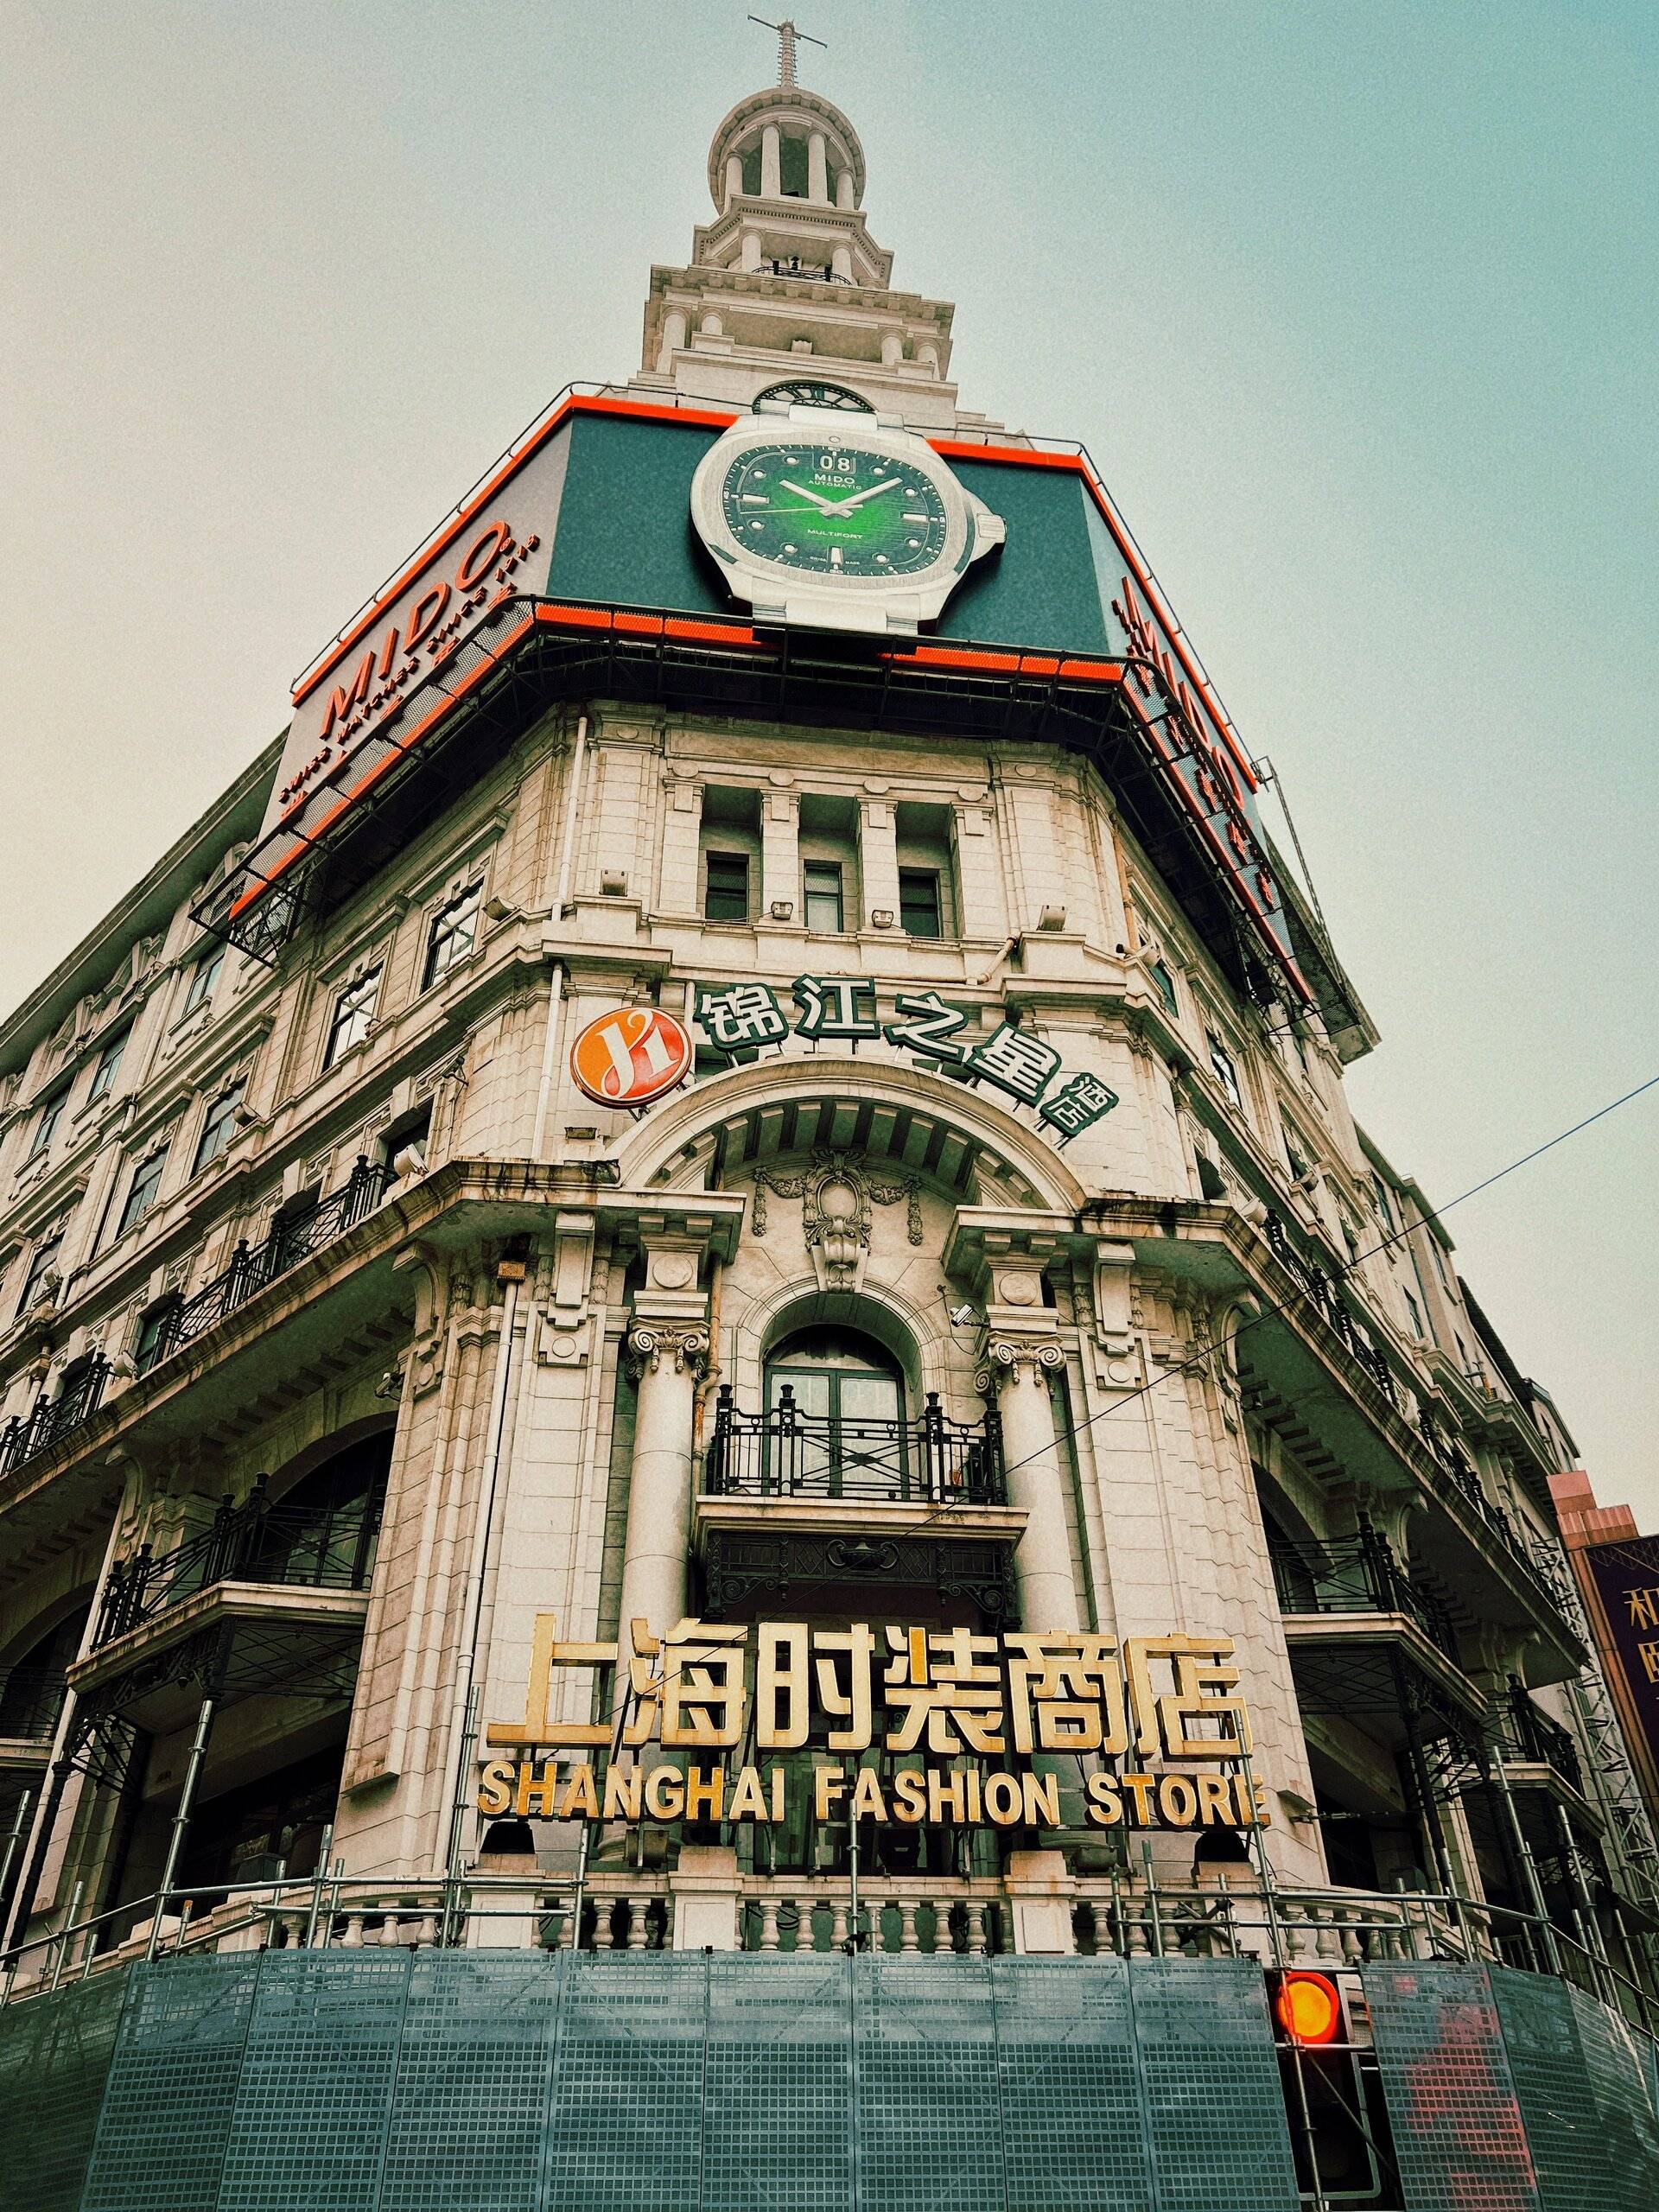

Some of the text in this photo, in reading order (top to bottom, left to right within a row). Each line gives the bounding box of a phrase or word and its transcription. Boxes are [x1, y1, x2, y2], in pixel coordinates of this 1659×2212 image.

[814, 474, 855, 484] MIDO
[819, 455, 850, 472] 08
[808, 480, 862, 490] AUTOMATIC
[807, 529, 863, 540] MULTIFORT
[319, 520, 508, 741] MIDO
[698, 976, 1059, 1098] 锦江之星
[486, 1613, 1254, 1755] 上海时装商店
[477, 1760, 1271, 1826] SHANGHAI FASHION STORE
